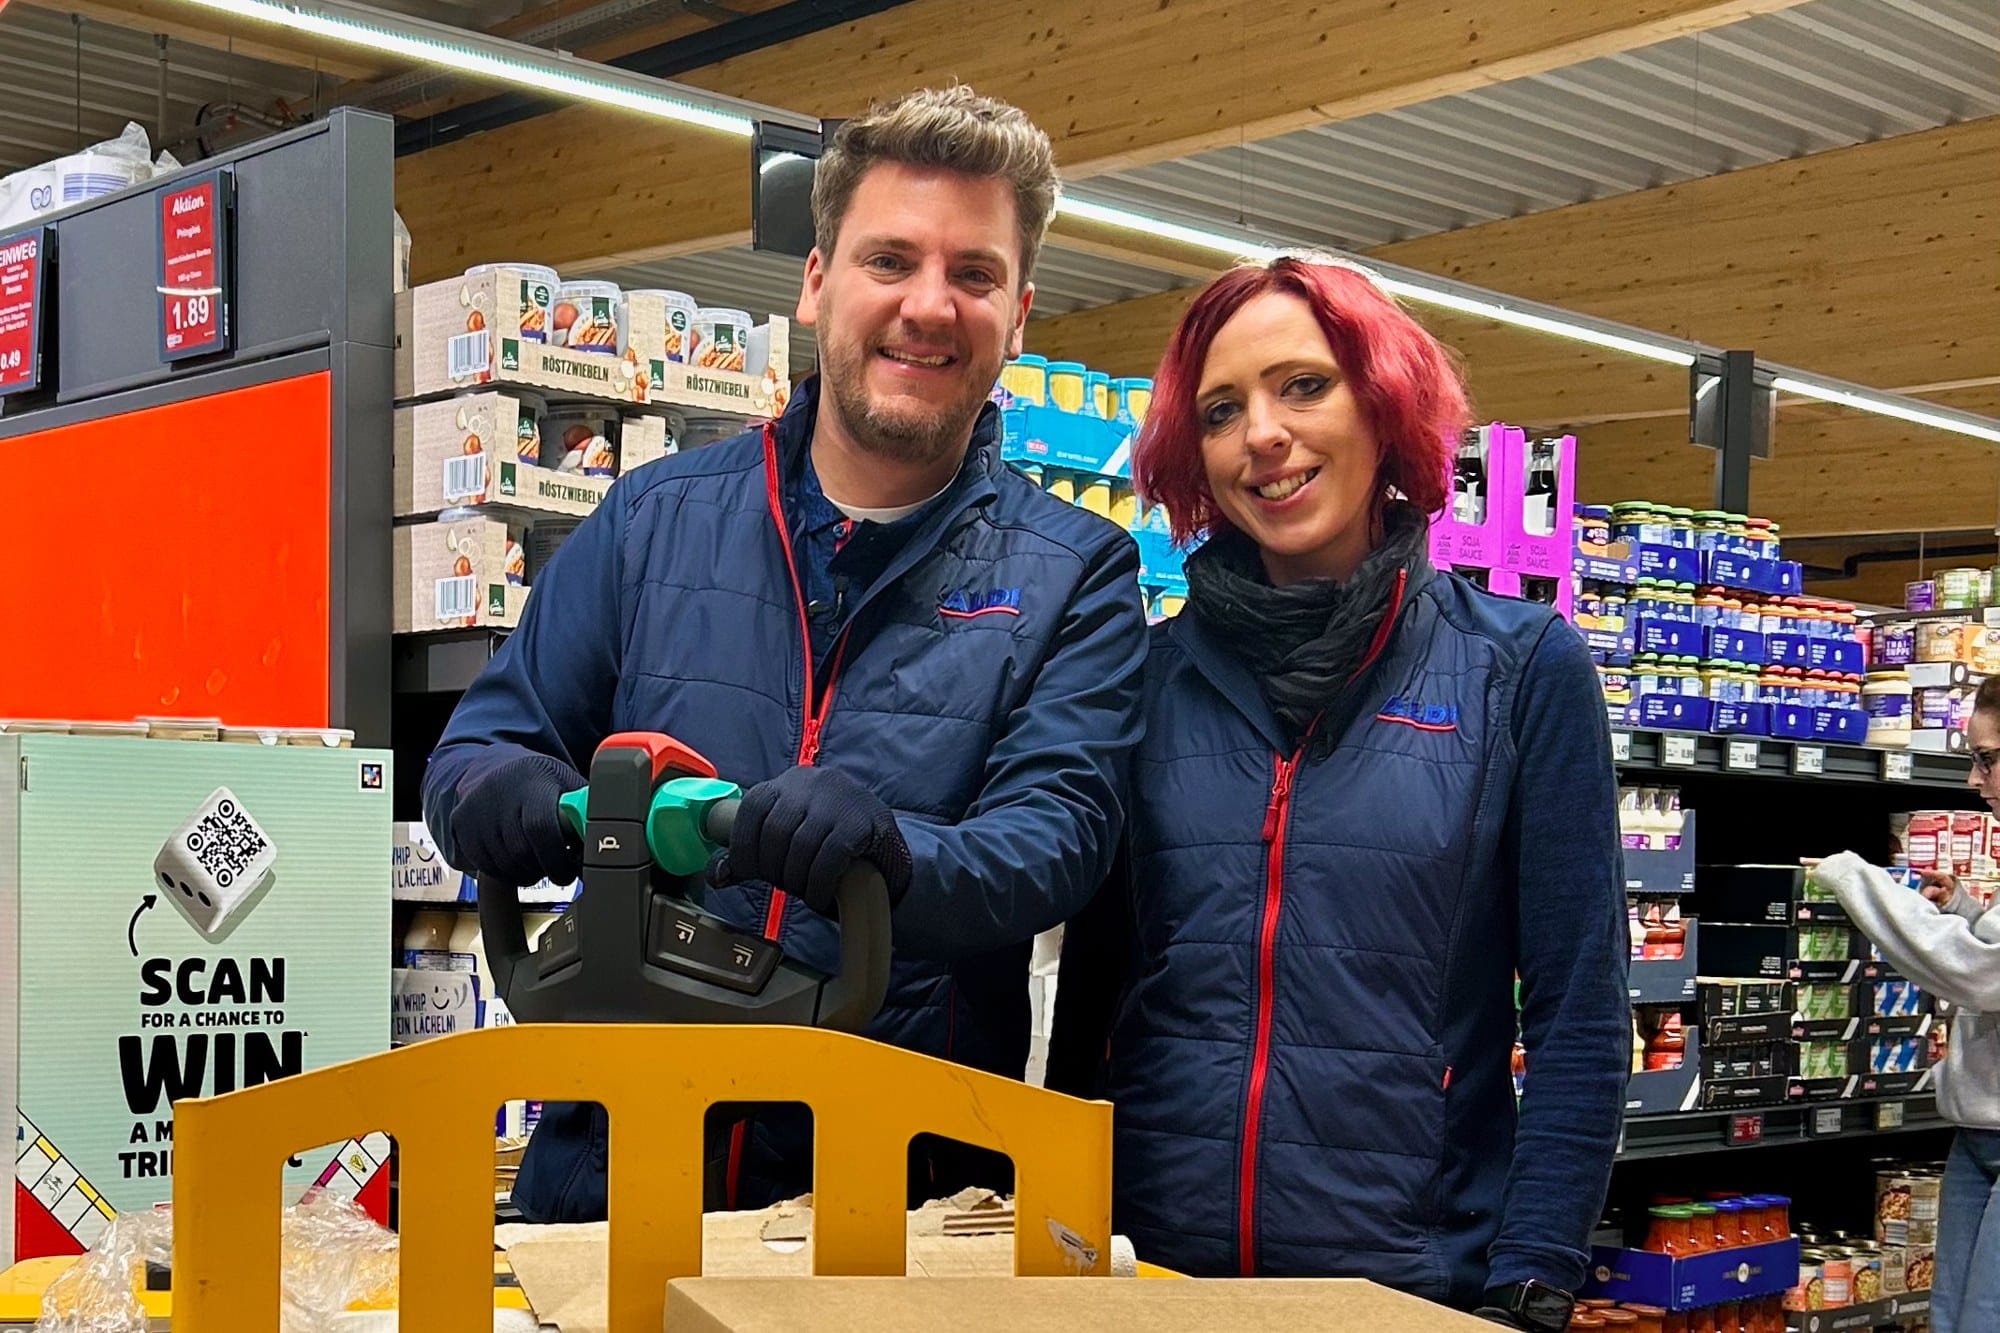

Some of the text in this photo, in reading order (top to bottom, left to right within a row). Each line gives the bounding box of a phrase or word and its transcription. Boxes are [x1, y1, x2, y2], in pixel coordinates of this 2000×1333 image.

[172, 195, 205, 216] Aktion
[172, 295, 210, 330] 1.89
[0, 349, 21, 370] 0.49
[542, 355, 609, 382] RÖSTZWIEBELN
[686, 374, 750, 398] RÖSTZWIEBELN
[140, 957, 286, 1006] SCAN
[141, 1010, 285, 1028] FOR A CHANCE TO
[397, 1013, 456, 1036] EIN LÄCHELN!
[118, 1030, 303, 1115] WIN
[129, 1122, 149, 1144] A
[118, 1150, 173, 1179] TRI
